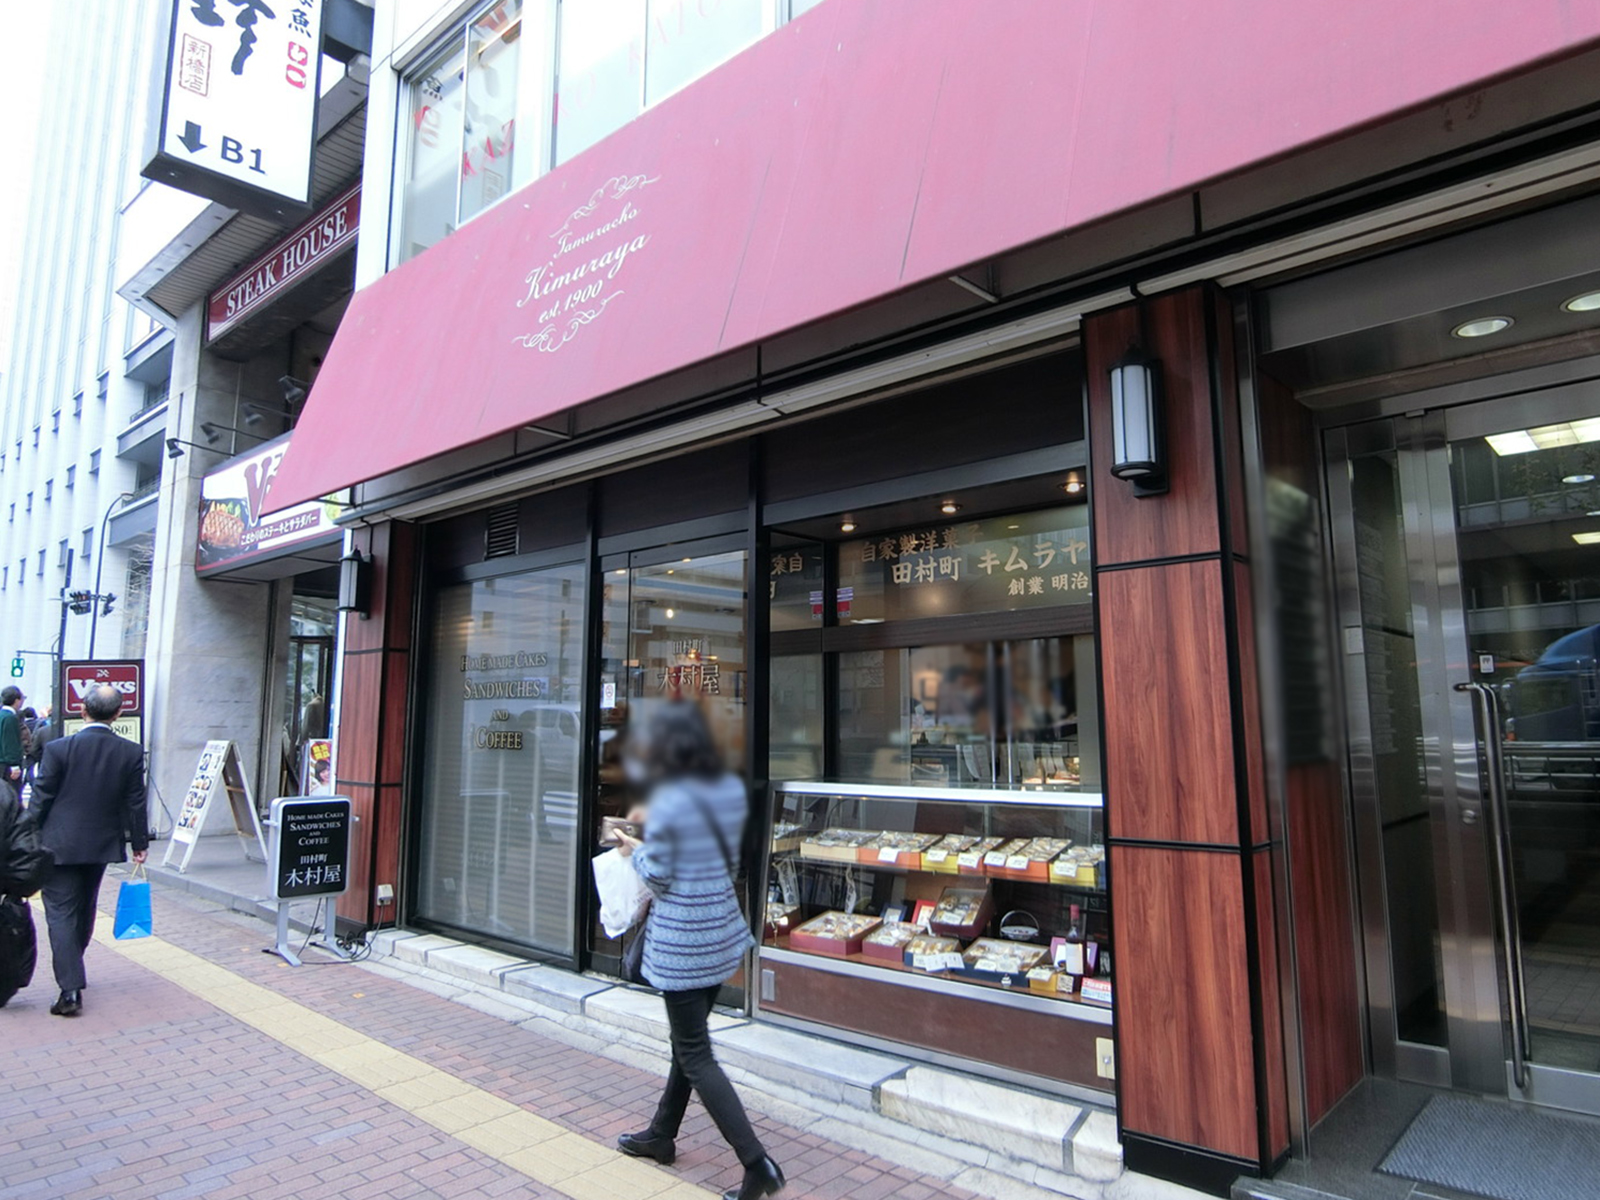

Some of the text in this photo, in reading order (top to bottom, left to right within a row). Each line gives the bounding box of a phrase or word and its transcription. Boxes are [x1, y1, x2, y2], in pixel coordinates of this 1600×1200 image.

[220, 135, 268, 175] B1
[553, 201, 642, 260] Tamuracho
[226, 206, 348, 318] STEAK HOUSE
[516, 234, 652, 308] Kimuraya
[564, 279, 603, 311] 1900
[891, 538, 1087, 584] 田村町 キムラヤ
[1008, 571, 1089, 596] 創業 明治
[515, 650, 548, 668] CAKES
[464, 678, 542, 700] SANDWICHES
[657, 664, 720, 695] 木村屋
[492, 709, 509, 721] AND
[475, 726, 523, 749] COFFEE
[290, 821, 341, 831] SANDWICHES
[298, 836, 330, 846] COFFEE
[284, 864, 341, 887] 木村屋
